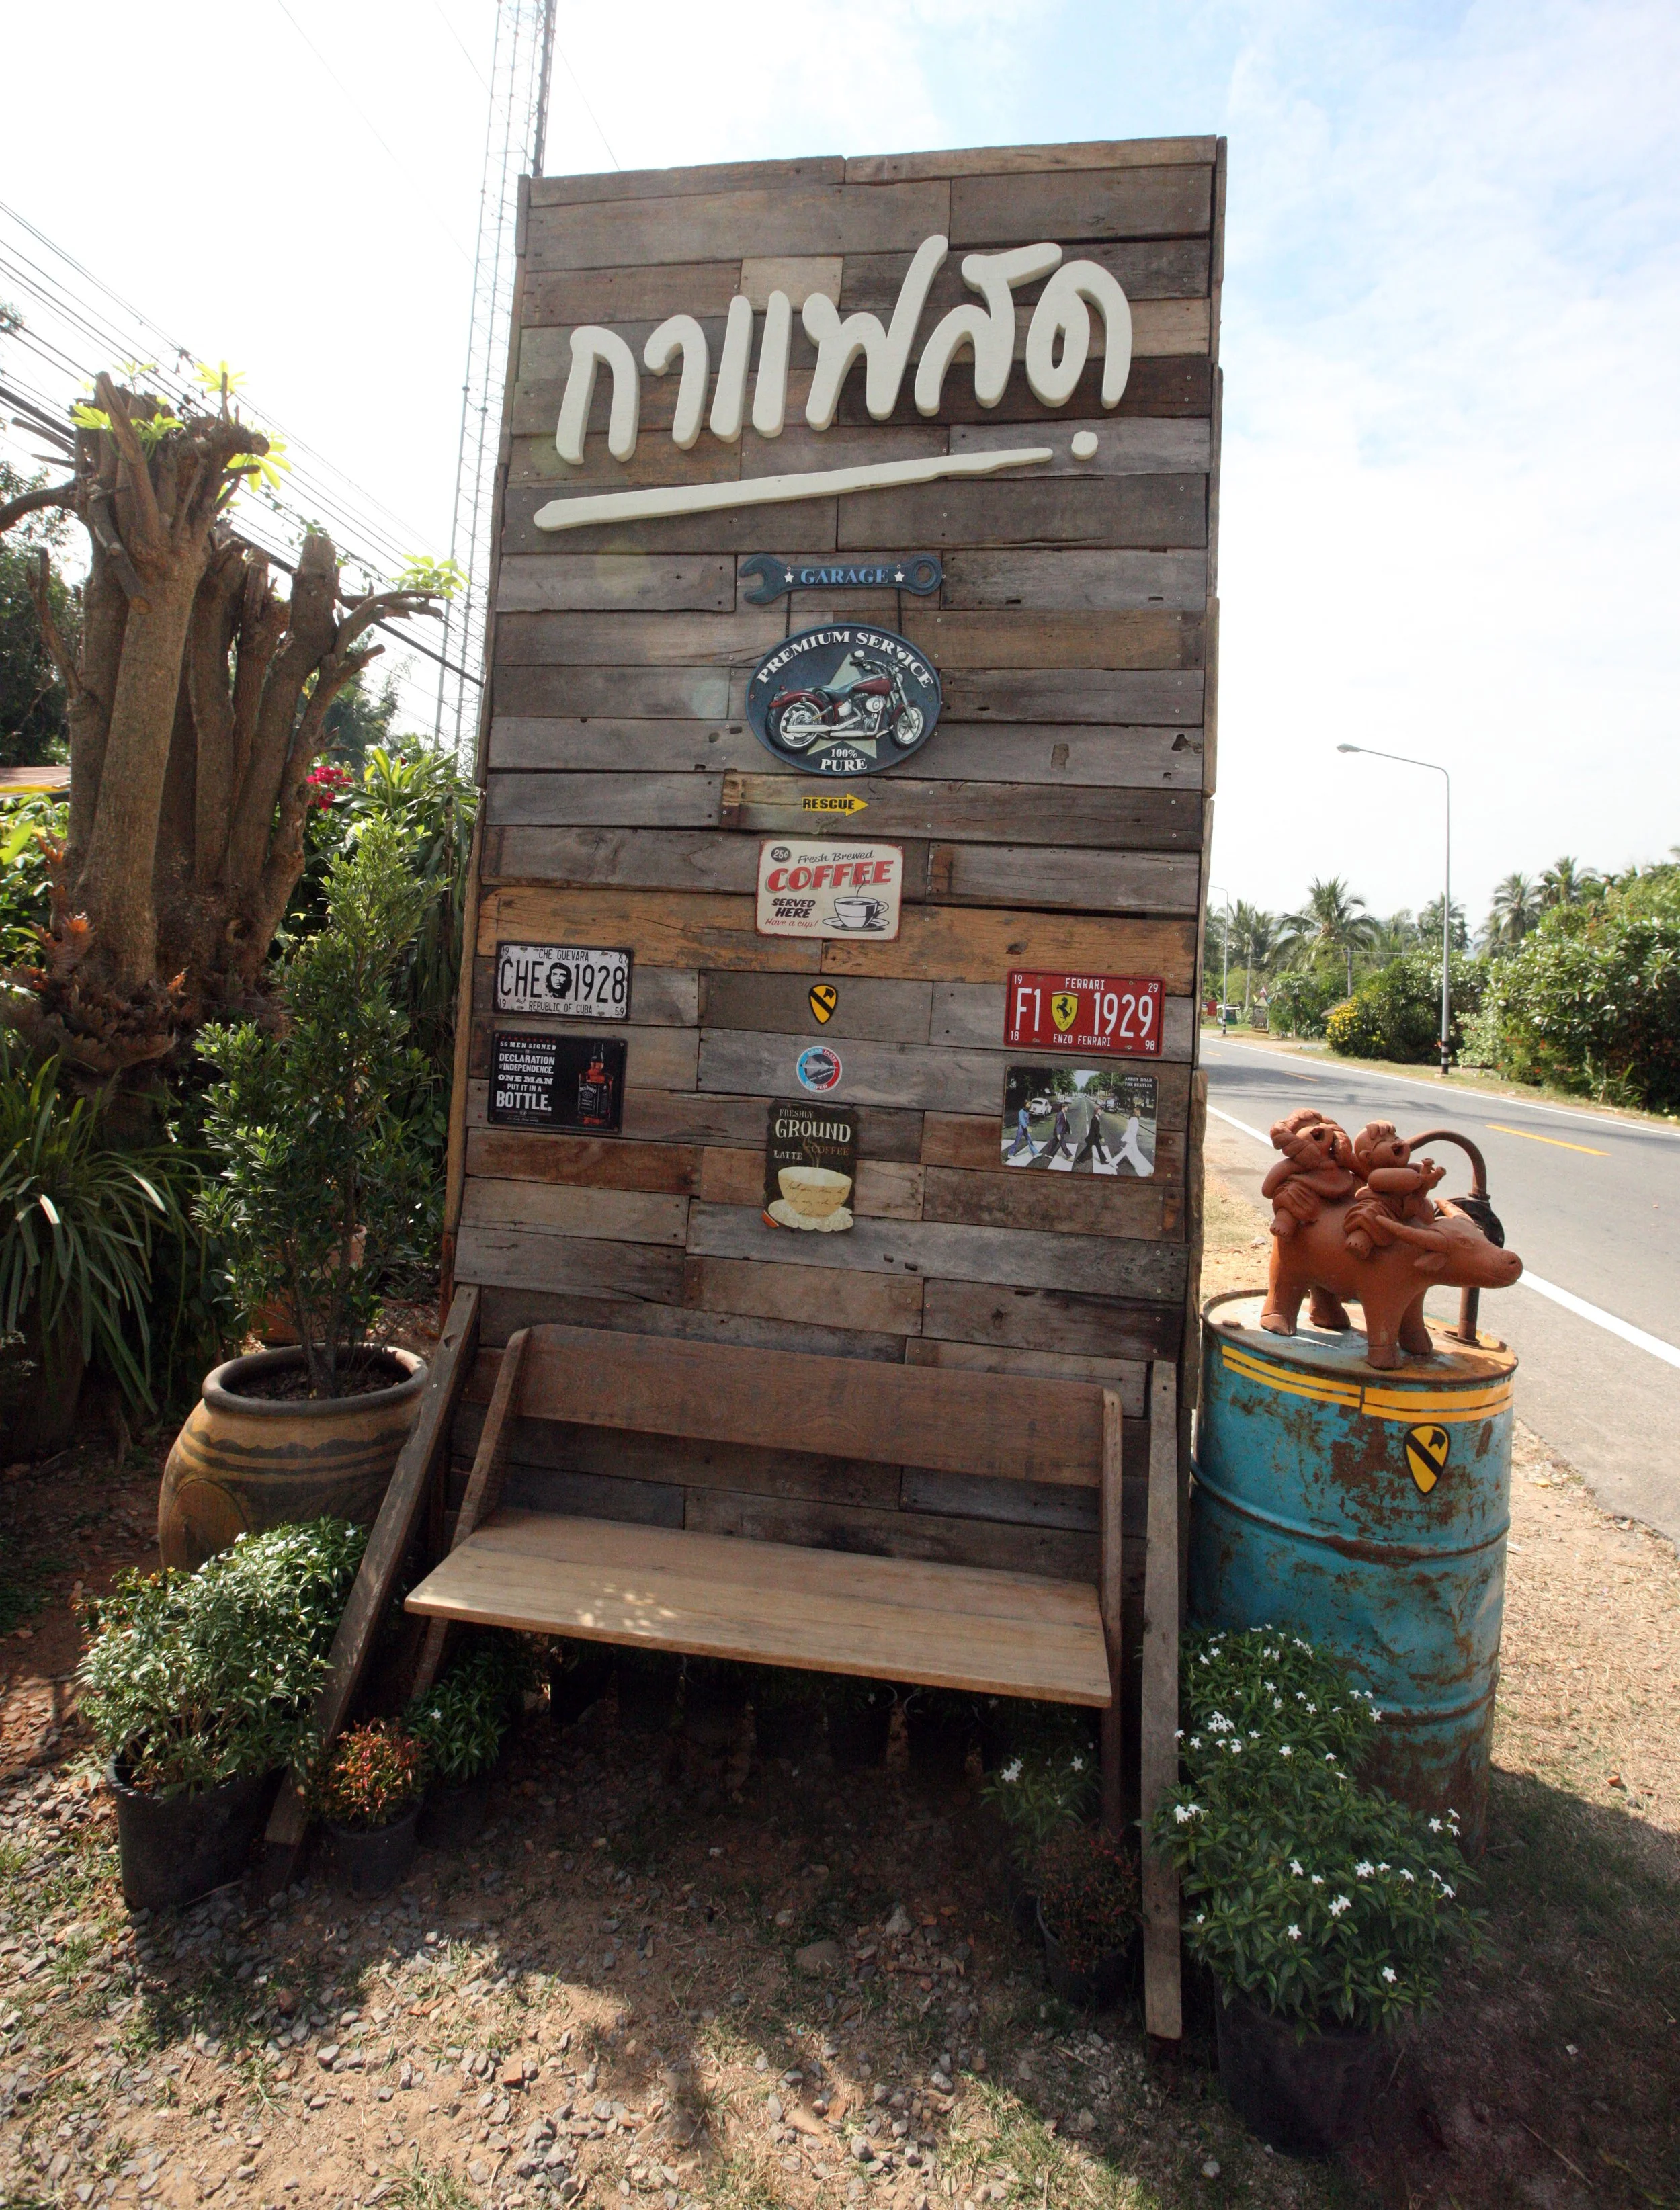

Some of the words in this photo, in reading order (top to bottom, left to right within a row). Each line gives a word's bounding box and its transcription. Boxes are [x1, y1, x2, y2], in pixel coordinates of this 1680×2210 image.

[556, 234, 1133, 466] กาแฟสด
[800, 569, 889, 585] GARAGE
[757, 631, 851, 685] PREMIUM
[855, 632, 934, 689] SERVICE
[830, 749, 858, 758] 100%
[818, 758, 868, 772] PURE
[802, 798, 855, 810] RESCUE
[773, 849, 789, 859] 25¢
[797, 853, 829, 864] Fresh
[832, 850, 874, 862] Brewed
[766, 860, 894, 892] COFFEE
[771, 898, 816, 908] SERVED
[775, 908, 813, 919] HERE
[765, 917, 786, 926] Have
[797, 919, 820, 929] cup!
[538, 949, 553, 959] CHE
[557, 950, 589, 962] GUEVARA
[499, 959, 544, 998] CHE
[574, 963, 626, 1004] 1928
[1013, 975, 1023, 984] 19
[1065, 978, 1105, 990] FERRARI
[1148, 983, 1159, 993] 29
[528, 1001, 561, 1013] REPUBLIC
[564, 1003, 572, 1013] OF
[576, 1004, 593, 1015] CUBA
[1015, 988, 1042, 1033] F1
[1093, 992, 1154, 1038] 1929
[1010, 1031, 1019, 1042] 18
[1053, 1033, 1073, 1044] ENZO
[1077, 1035, 1111, 1047] FERRARI
[1145, 1040, 1155, 1051] 98
[499, 1053, 556, 1066] DECLARATION
[503, 1063, 554, 1074] INDEPENDENCE.
[497, 1074, 523, 1082] ONE
[523, 1076, 554, 1085] MAN
[507, 1082, 520, 1091] PUT
[496, 1090, 552, 1111] BOTTLE.
[780, 1109, 814, 1119] FRESHLY
[775, 1118, 851, 1143] GROUND
[773, 1150, 803, 1160] LATTE
[811, 1144, 850, 1156] COFFEE
